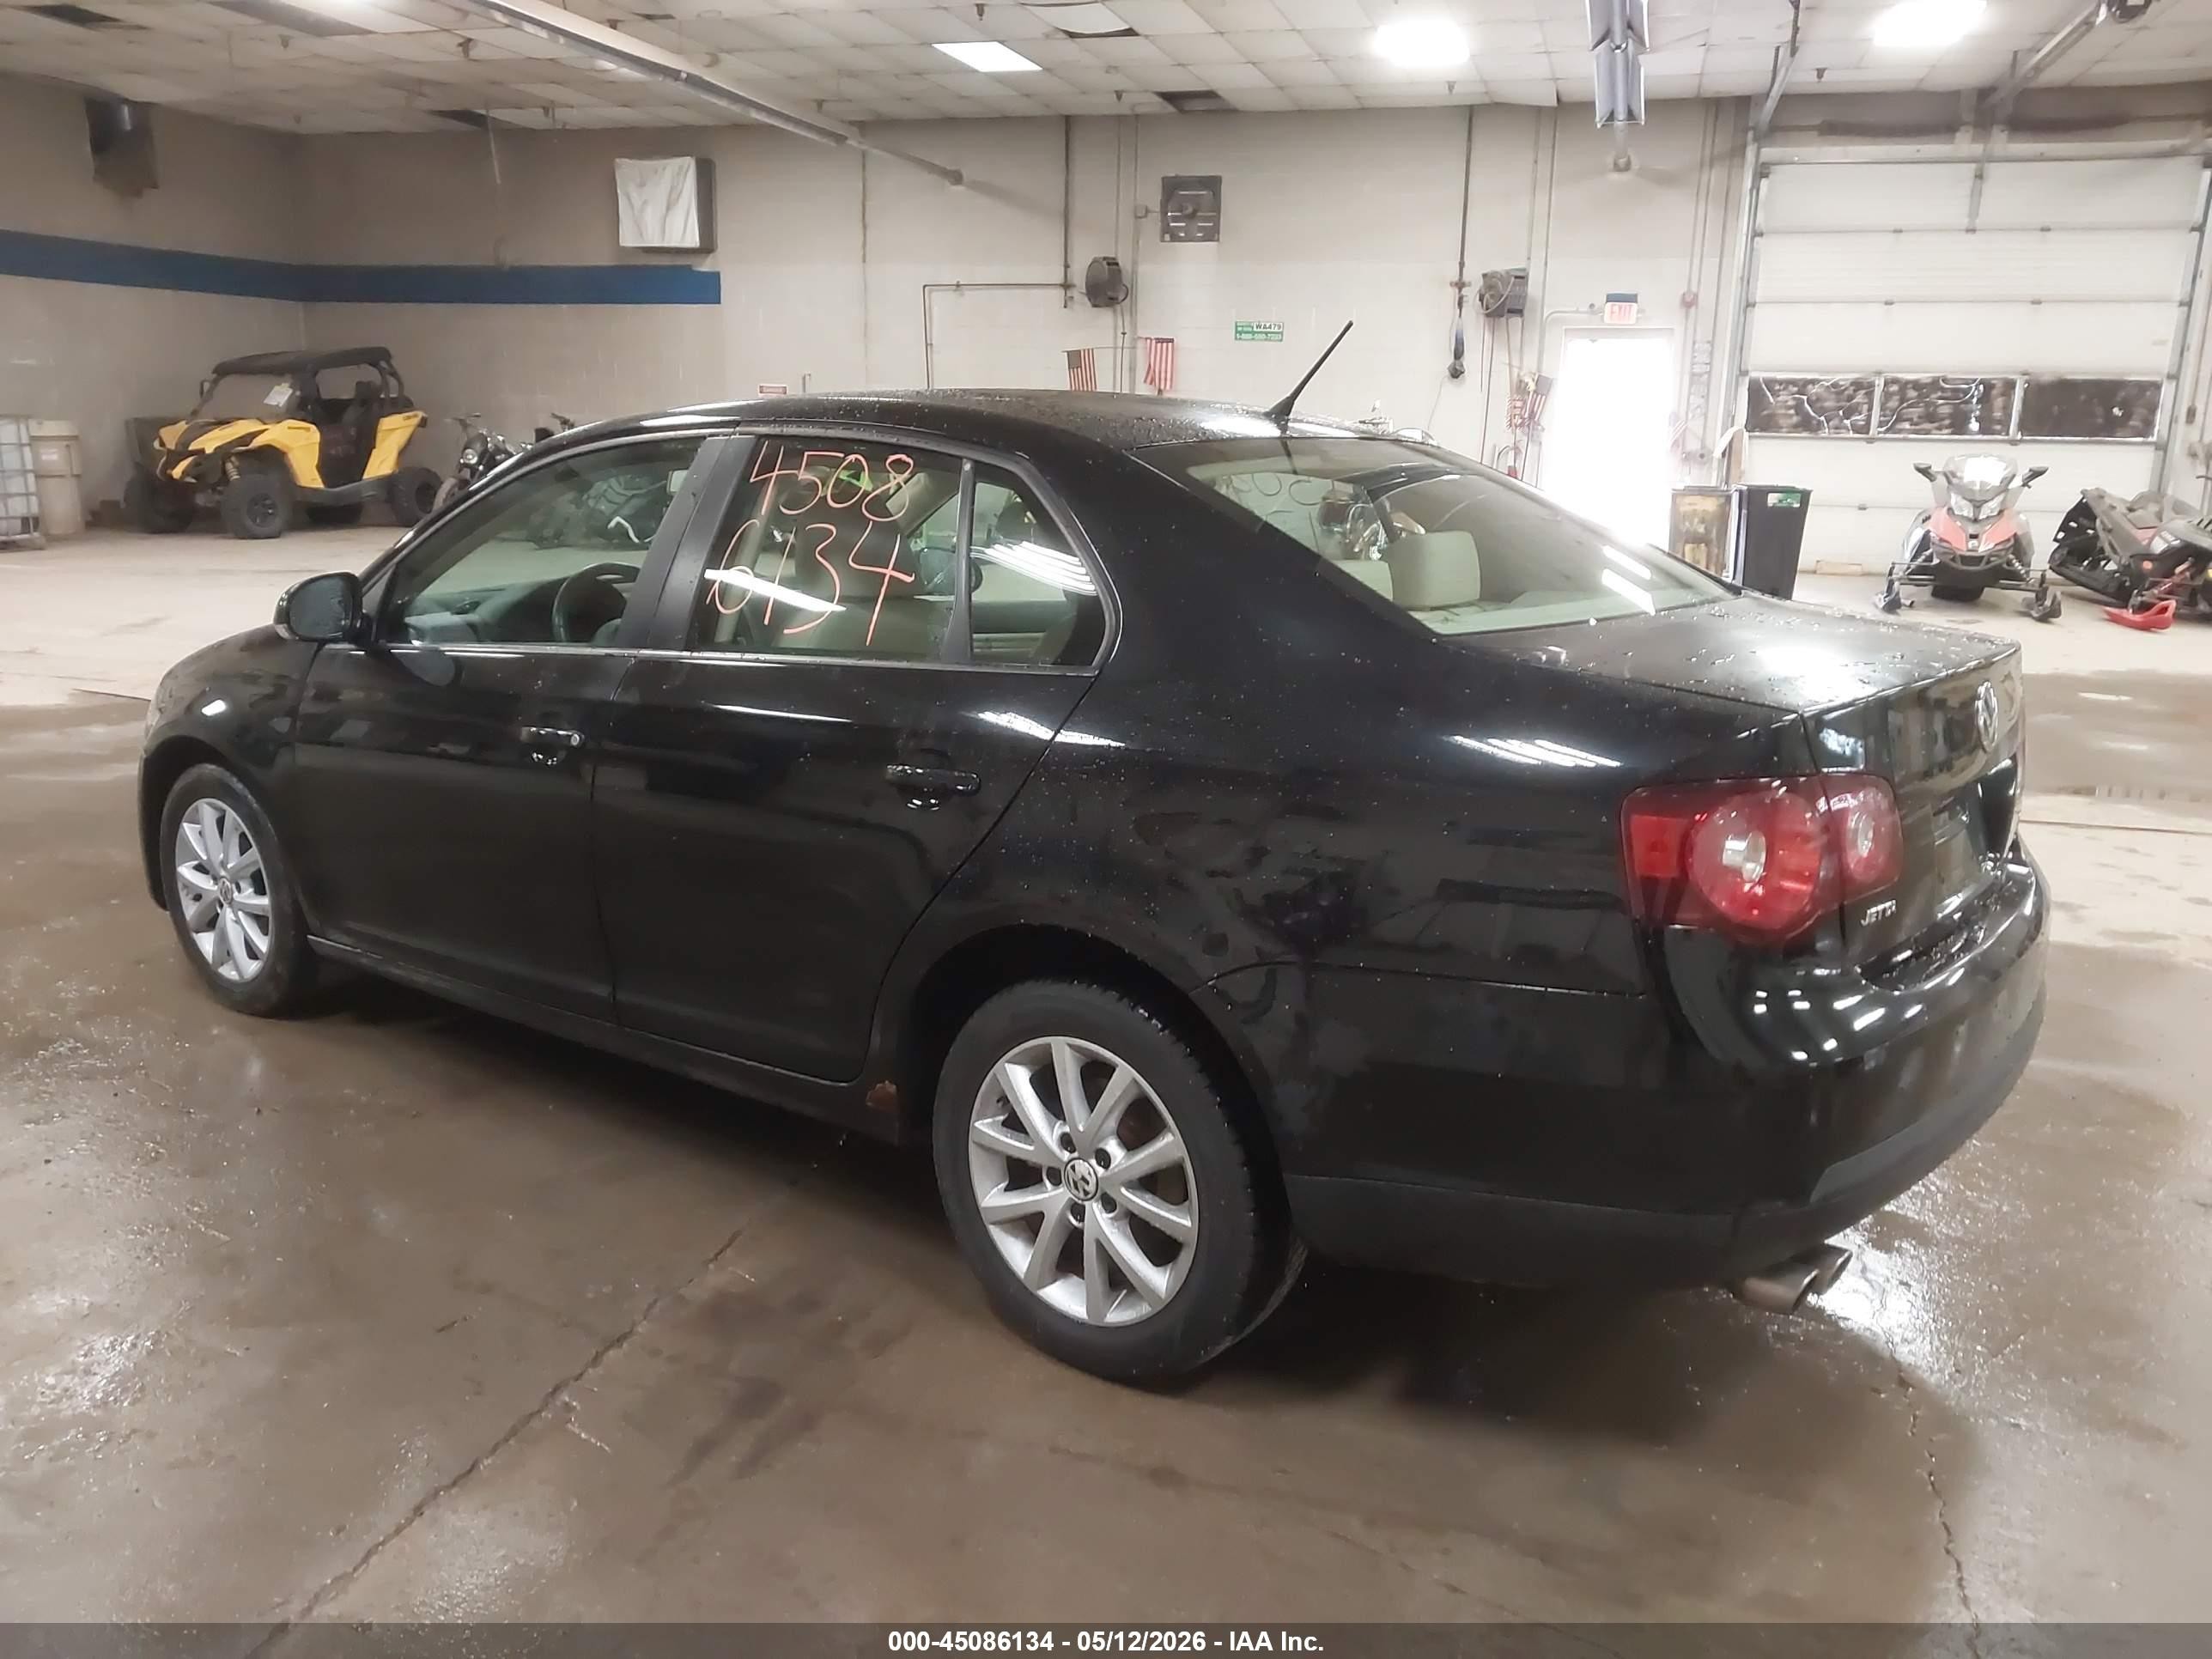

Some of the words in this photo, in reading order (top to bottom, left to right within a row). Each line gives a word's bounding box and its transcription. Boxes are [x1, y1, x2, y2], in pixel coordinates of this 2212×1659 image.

[1610, 303, 1634, 321] EXIT
[1255, 322, 1282, 331] WA479
[748, 439, 915, 522] 4508
